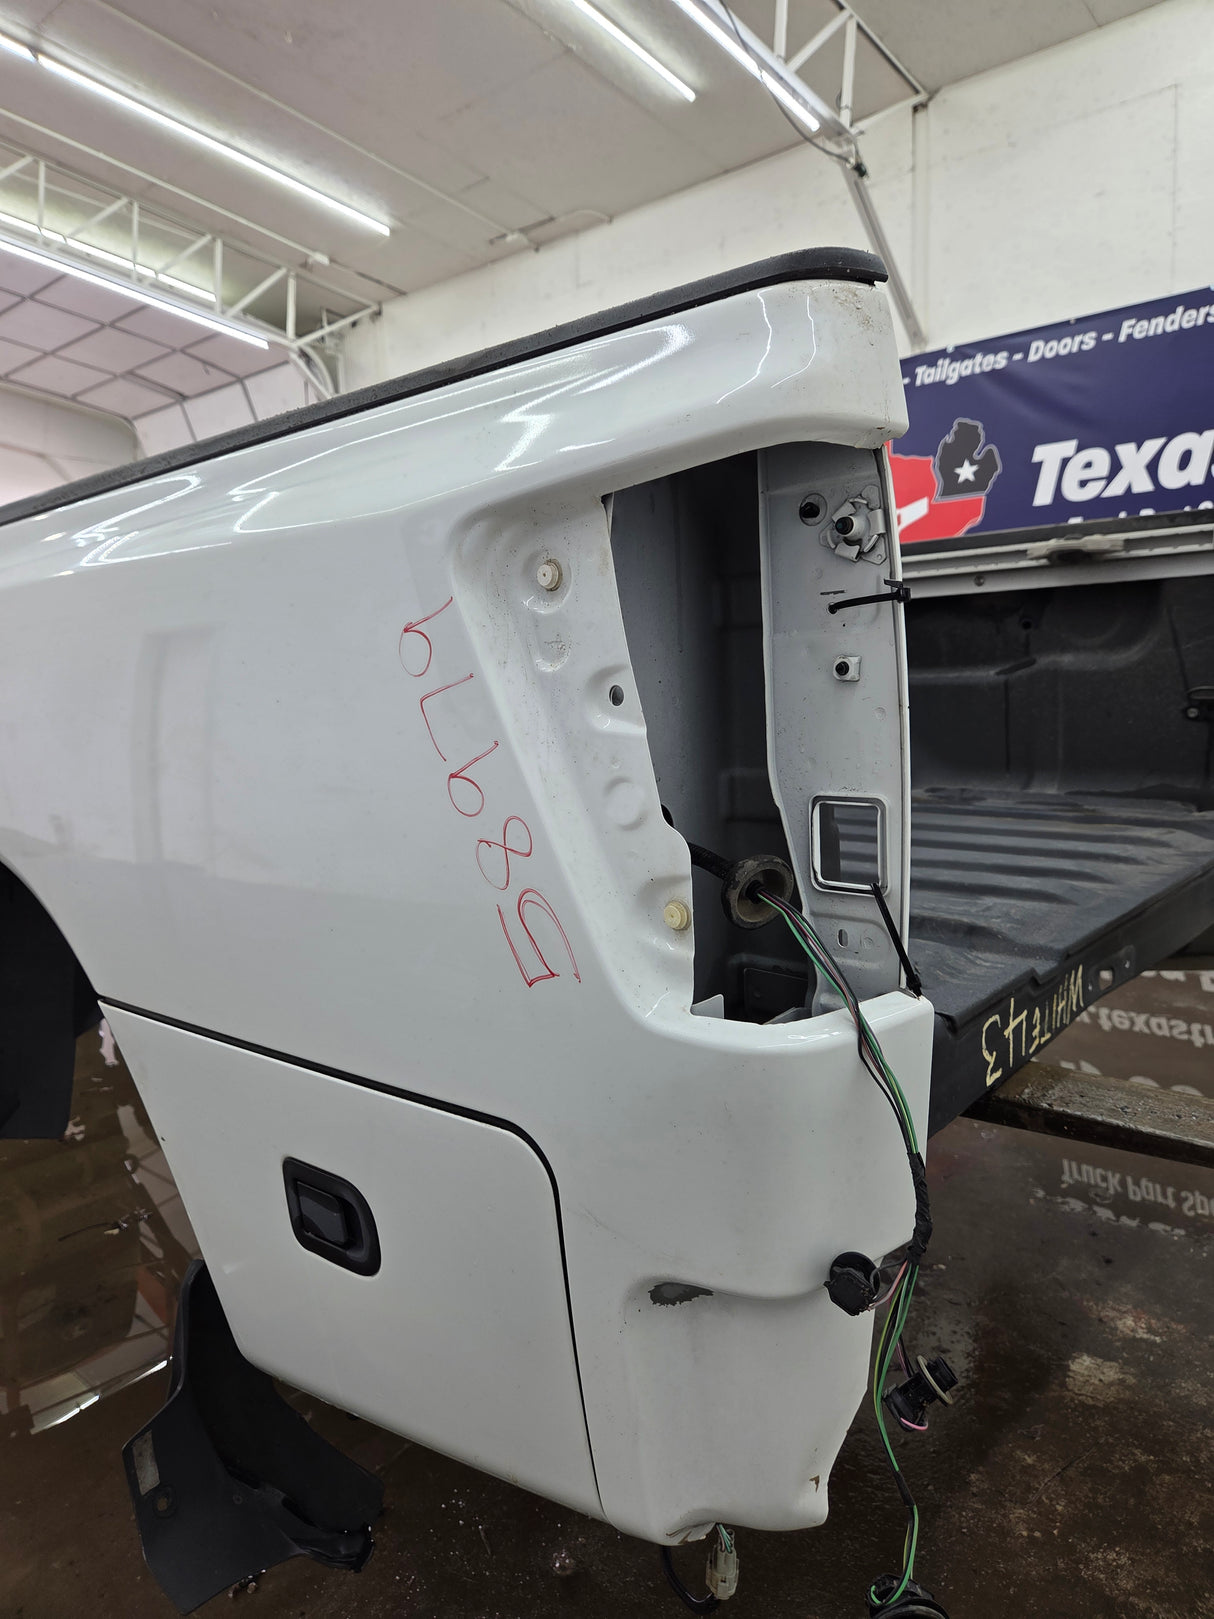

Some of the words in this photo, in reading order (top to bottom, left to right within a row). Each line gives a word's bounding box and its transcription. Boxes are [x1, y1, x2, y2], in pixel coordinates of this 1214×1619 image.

[915, 350, 1009, 386] Tailgates
[1027, 331, 1098, 363] Doors
[1032, 429, 1214, 507] Texa
[399, 596, 581, 988] 58979
